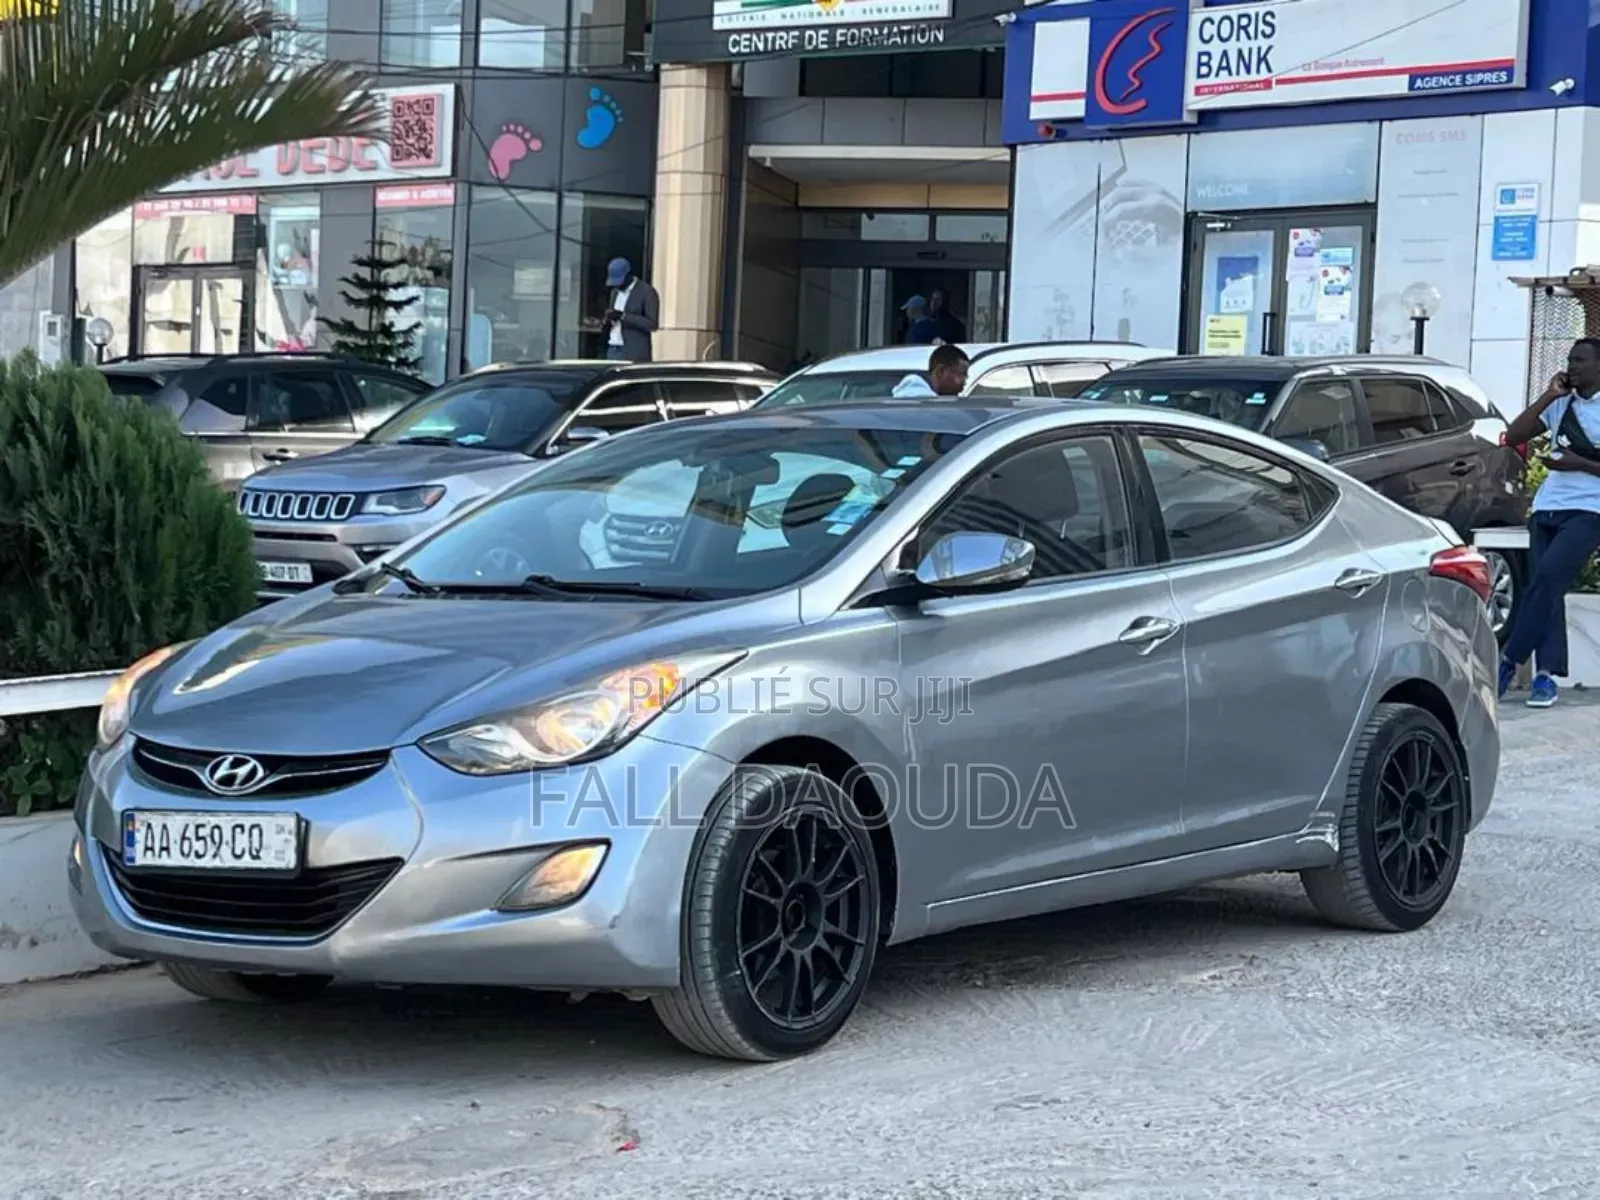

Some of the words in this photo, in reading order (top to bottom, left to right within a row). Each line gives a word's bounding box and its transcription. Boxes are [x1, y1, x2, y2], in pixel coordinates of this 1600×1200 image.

[781, 9, 845, 21] NATIONALE
[1198, 10, 1276, 44] CORIS
[728, 31, 799, 53] CENTRE
[805, 30, 829, 49] DE
[836, 24, 944, 47] FORMATION
[1196, 45, 1274, 79] BANK
[1414, 73, 1462, 89] AGENCE
[1466, 71, 1507, 86] SIPRES
[143, 822, 171, 858] AA
[180, 823, 223, 860] 659
